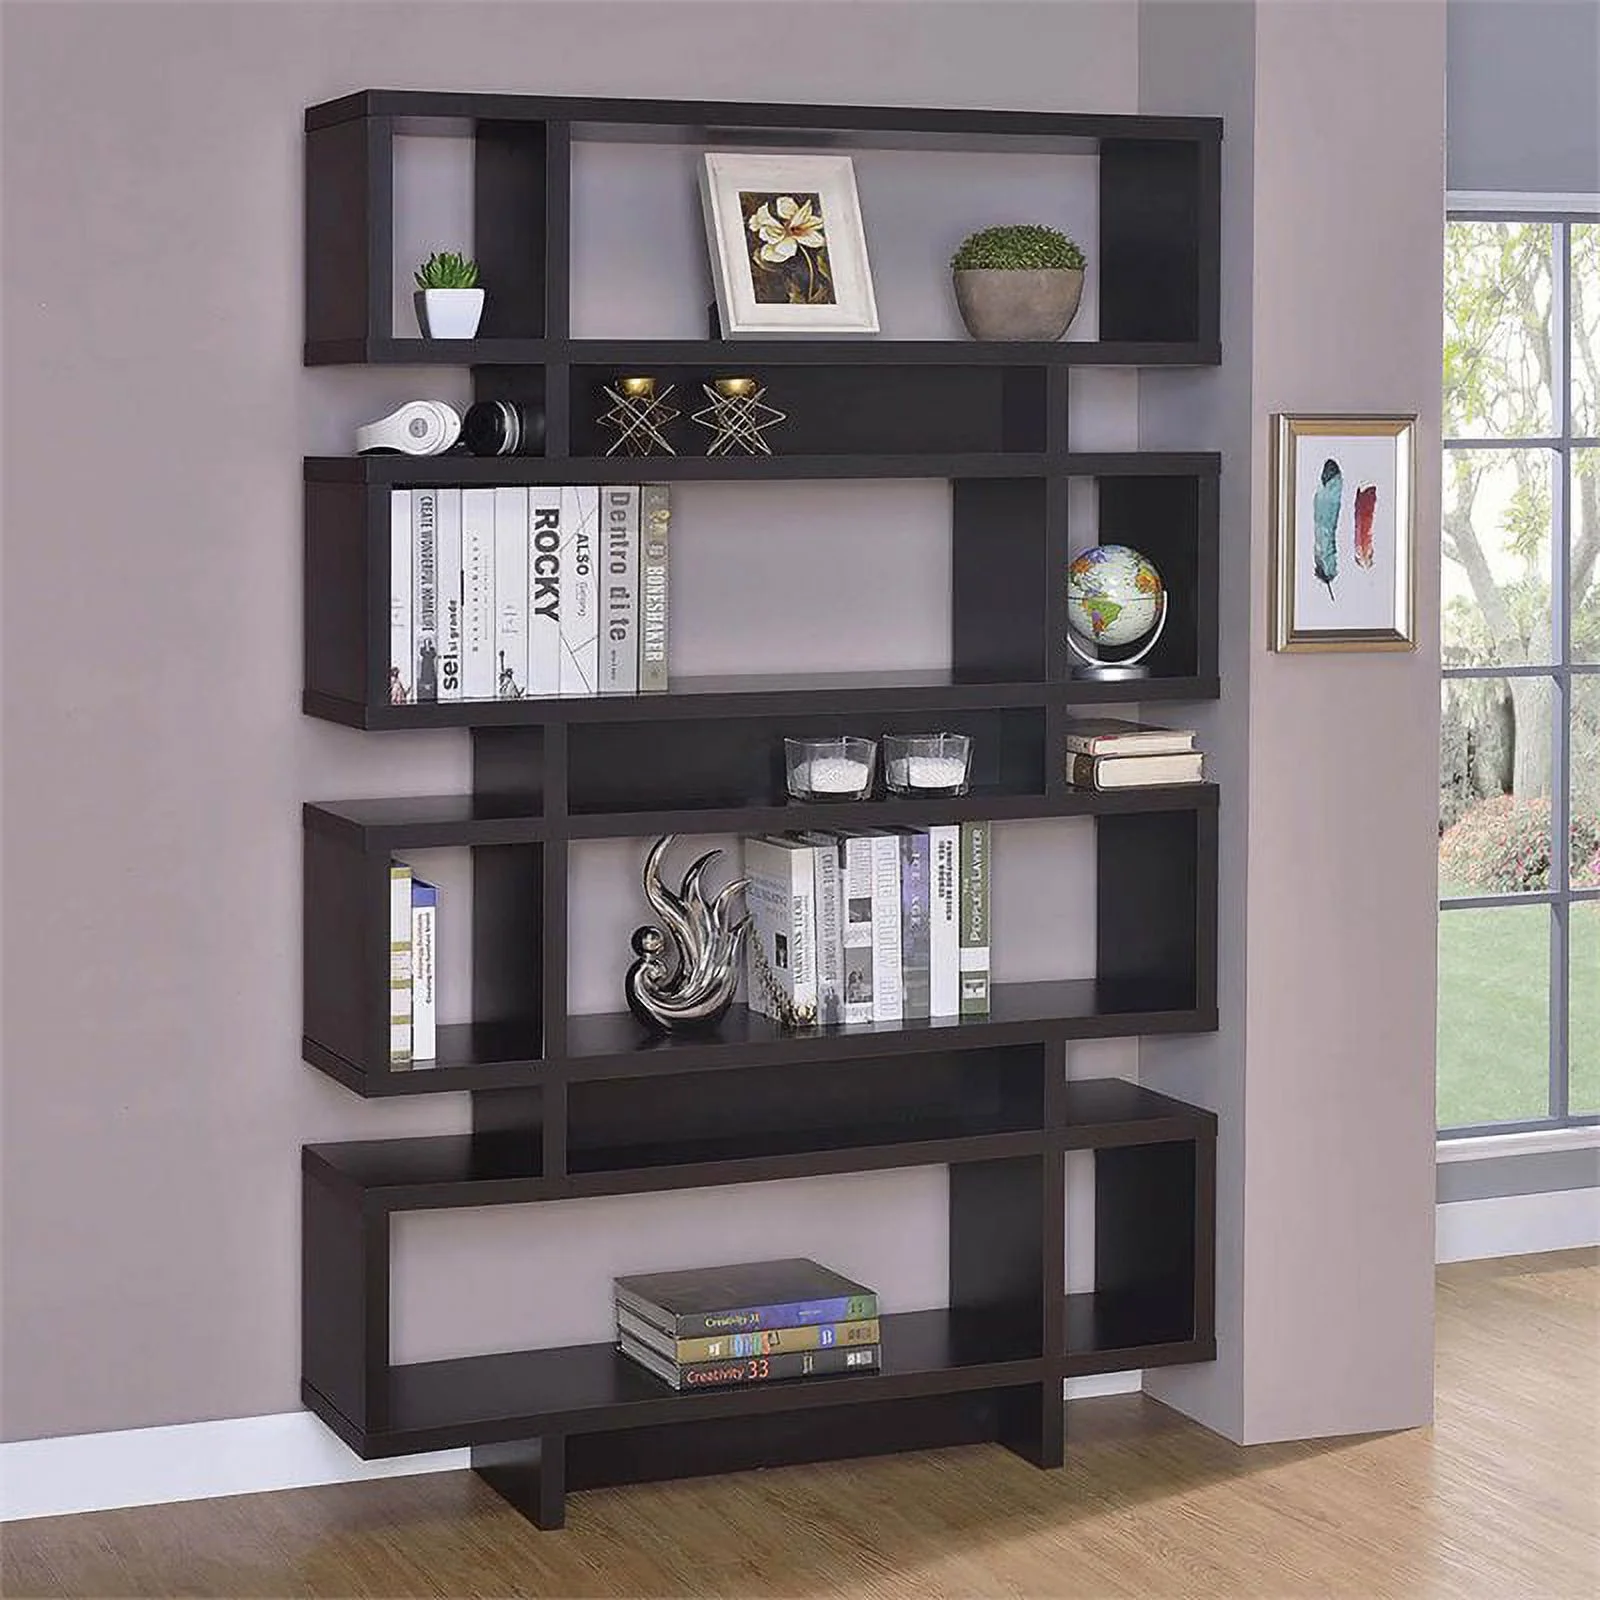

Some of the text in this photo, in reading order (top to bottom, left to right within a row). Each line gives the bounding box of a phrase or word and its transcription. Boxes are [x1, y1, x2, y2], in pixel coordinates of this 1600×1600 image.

[420, 496, 433, 527] CREATE
[534, 508, 560, 622] ROCKY
[576, 533, 590, 576] ALSO
[609, 492, 631, 641] Dentro di te
[645, 566, 666, 662] BONESHAKER
[437, 653, 458, 690] sei
[686, 1360, 769, 1384] Creativity 33
